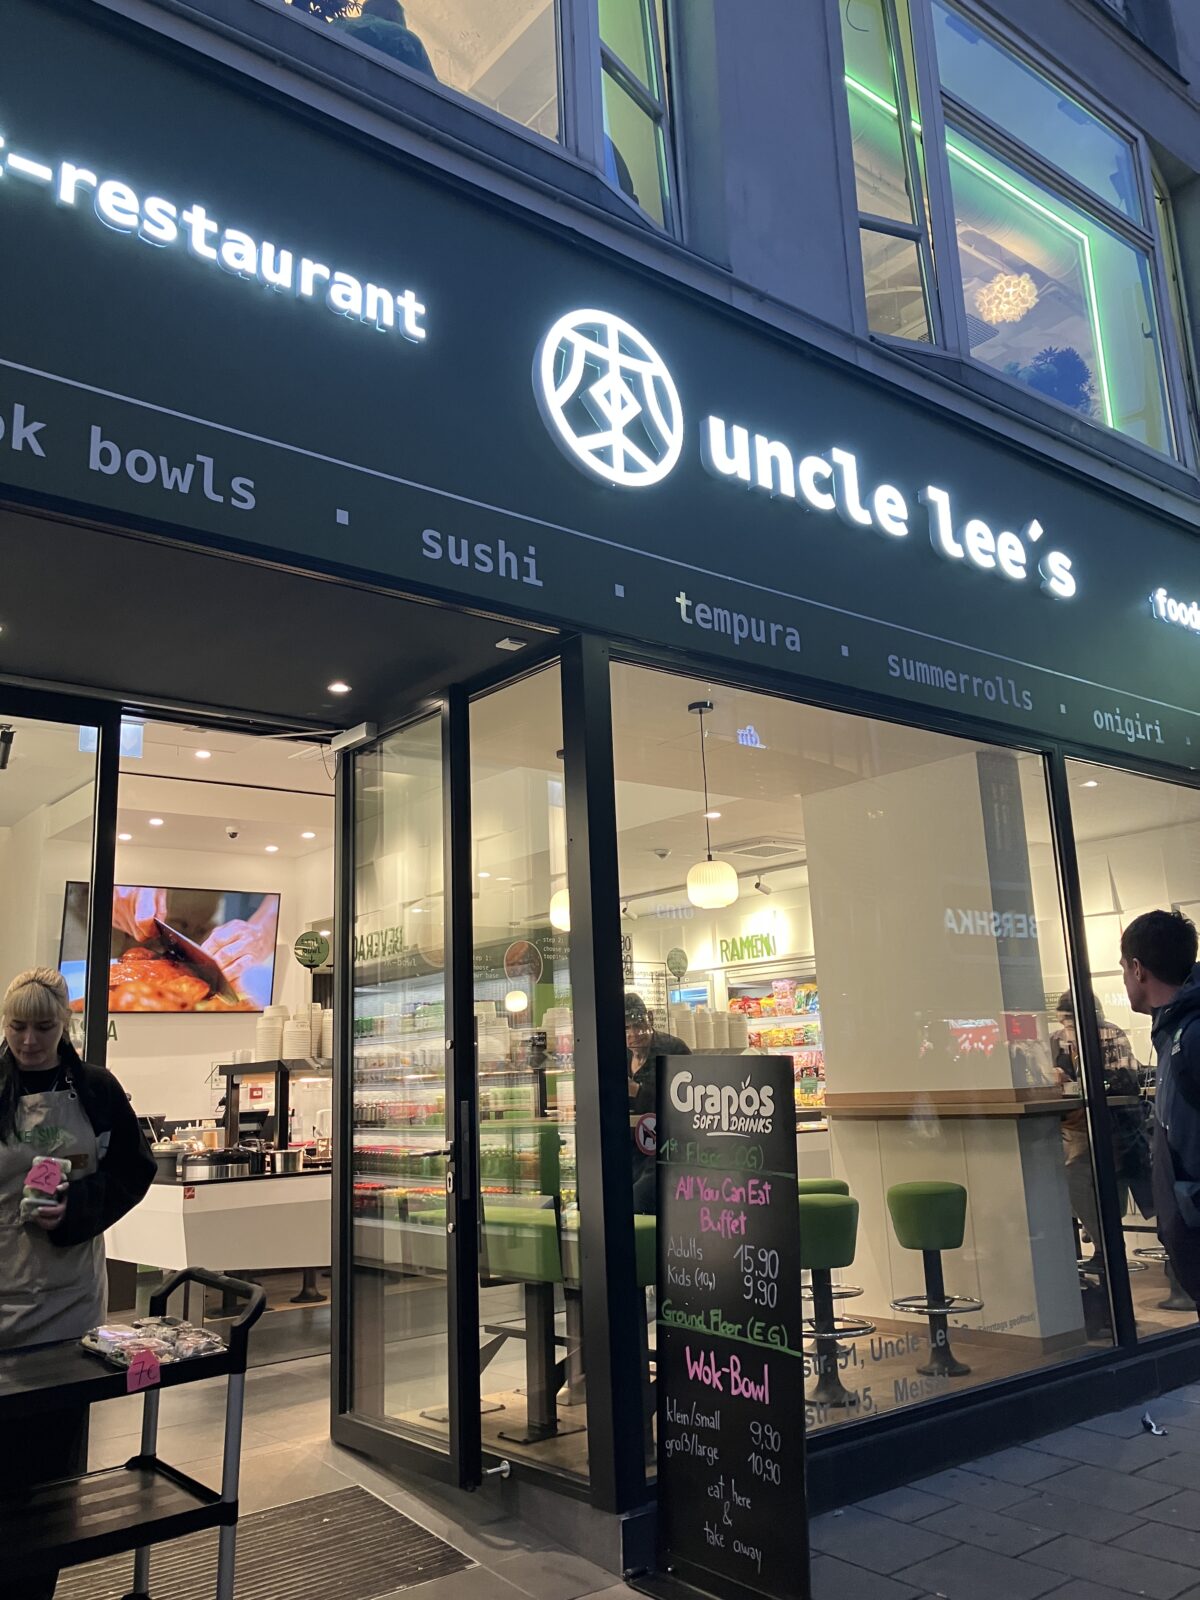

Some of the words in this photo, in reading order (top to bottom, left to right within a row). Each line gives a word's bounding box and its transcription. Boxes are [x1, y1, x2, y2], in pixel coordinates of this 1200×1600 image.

[0, 136, 427, 340] -restaurant
[0, 403, 47, 457] k
[89, 426, 257, 511] bowls
[702, 415, 909, 537] uncle
[422, 529, 543, 587] sushi
[675, 591, 801, 653] tempura
[1154, 587, 1200, 631] food
[888, 654, 1033, 711] summerrolls
[1093, 708, 1165, 745] onigiri
[719, 933, 771, 963] RAMEN
[692, 1114, 720, 1130] SOFT
[729, 1115, 773, 1134] DRINKS
[675, 1175, 694, 1201] All
[696, 1176, 719, 1201] You
[721, 1177, 746, 1203] Can
[747, 1179, 772, 1205] Eat
[700, 1206, 747, 1239] Buffet
[667, 1264, 692, 1287] Kids
[661, 1298, 706, 1330] Ground
[709, 1309, 742, 1336] Floor
[870, 1331, 919, 1361] Uncle
[685, 1345, 769, 1405] Wok-Bowl
[707, 1475, 725, 1500] eat
[731, 1478, 751, 1509] here
[722, 1500, 733, 1526] &
[703, 1520, 726, 1549] take
[733, 1538, 762, 1574] away
